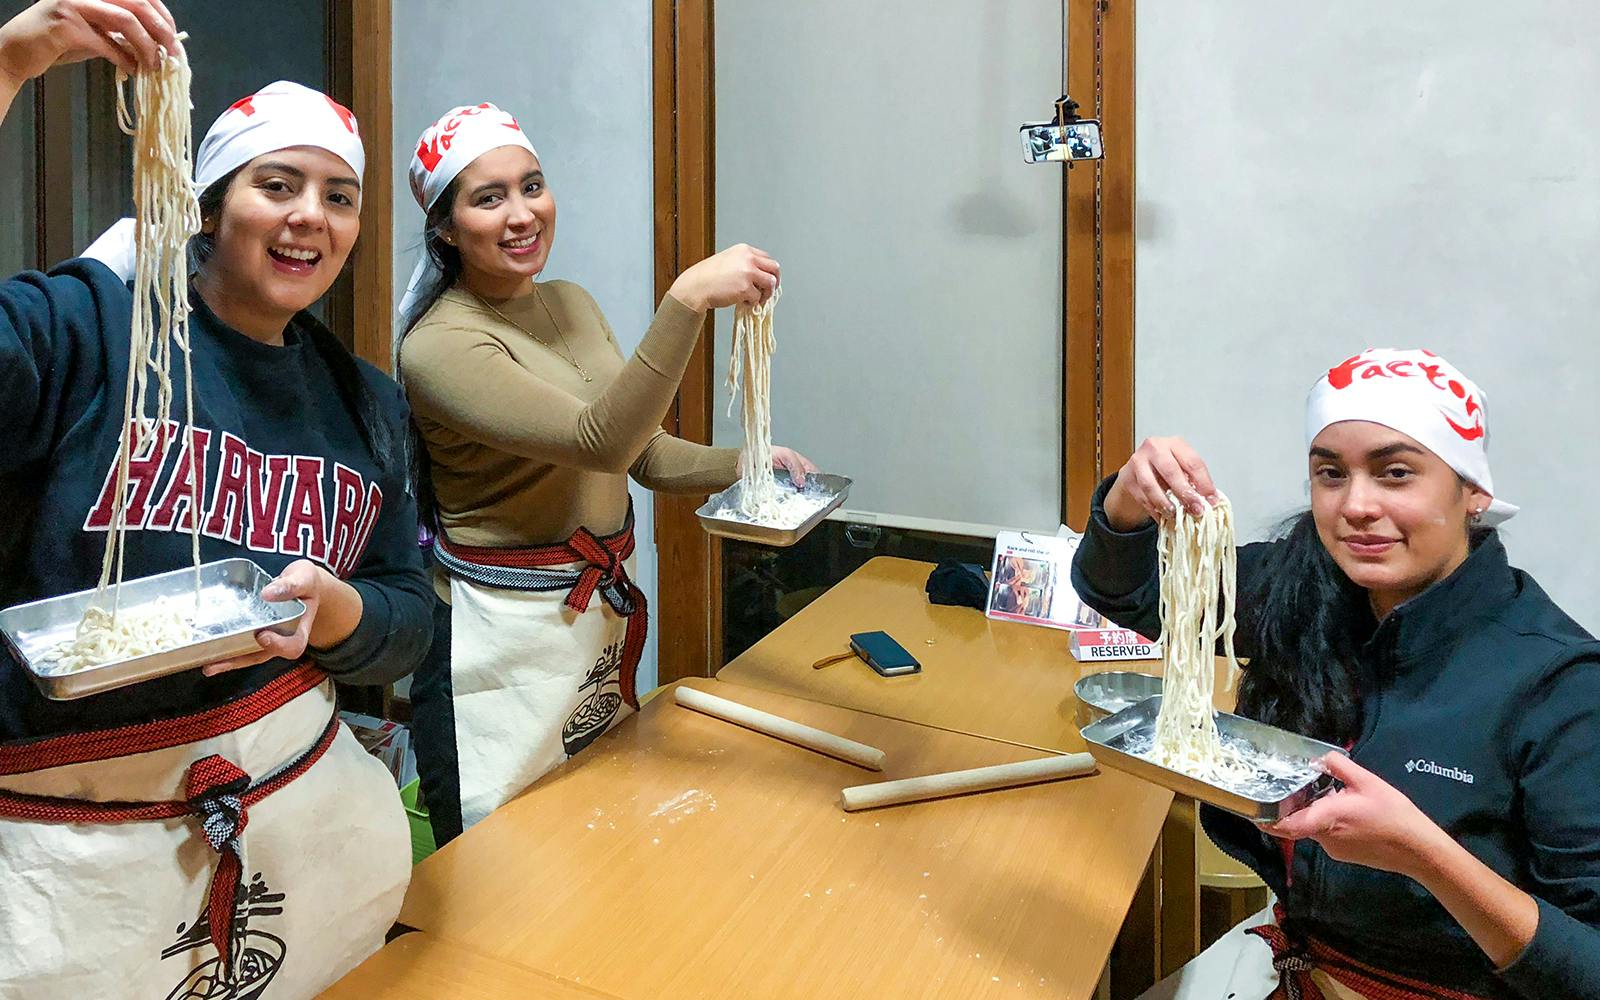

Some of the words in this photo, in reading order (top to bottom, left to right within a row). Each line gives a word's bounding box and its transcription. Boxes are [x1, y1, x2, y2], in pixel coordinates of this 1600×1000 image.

[83, 417, 383, 581] HARVARD
[1100, 630, 1138, 645] 予約席
[1091, 645, 1151, 657] RESERVED
[1415, 759, 1474, 784] Columbia
